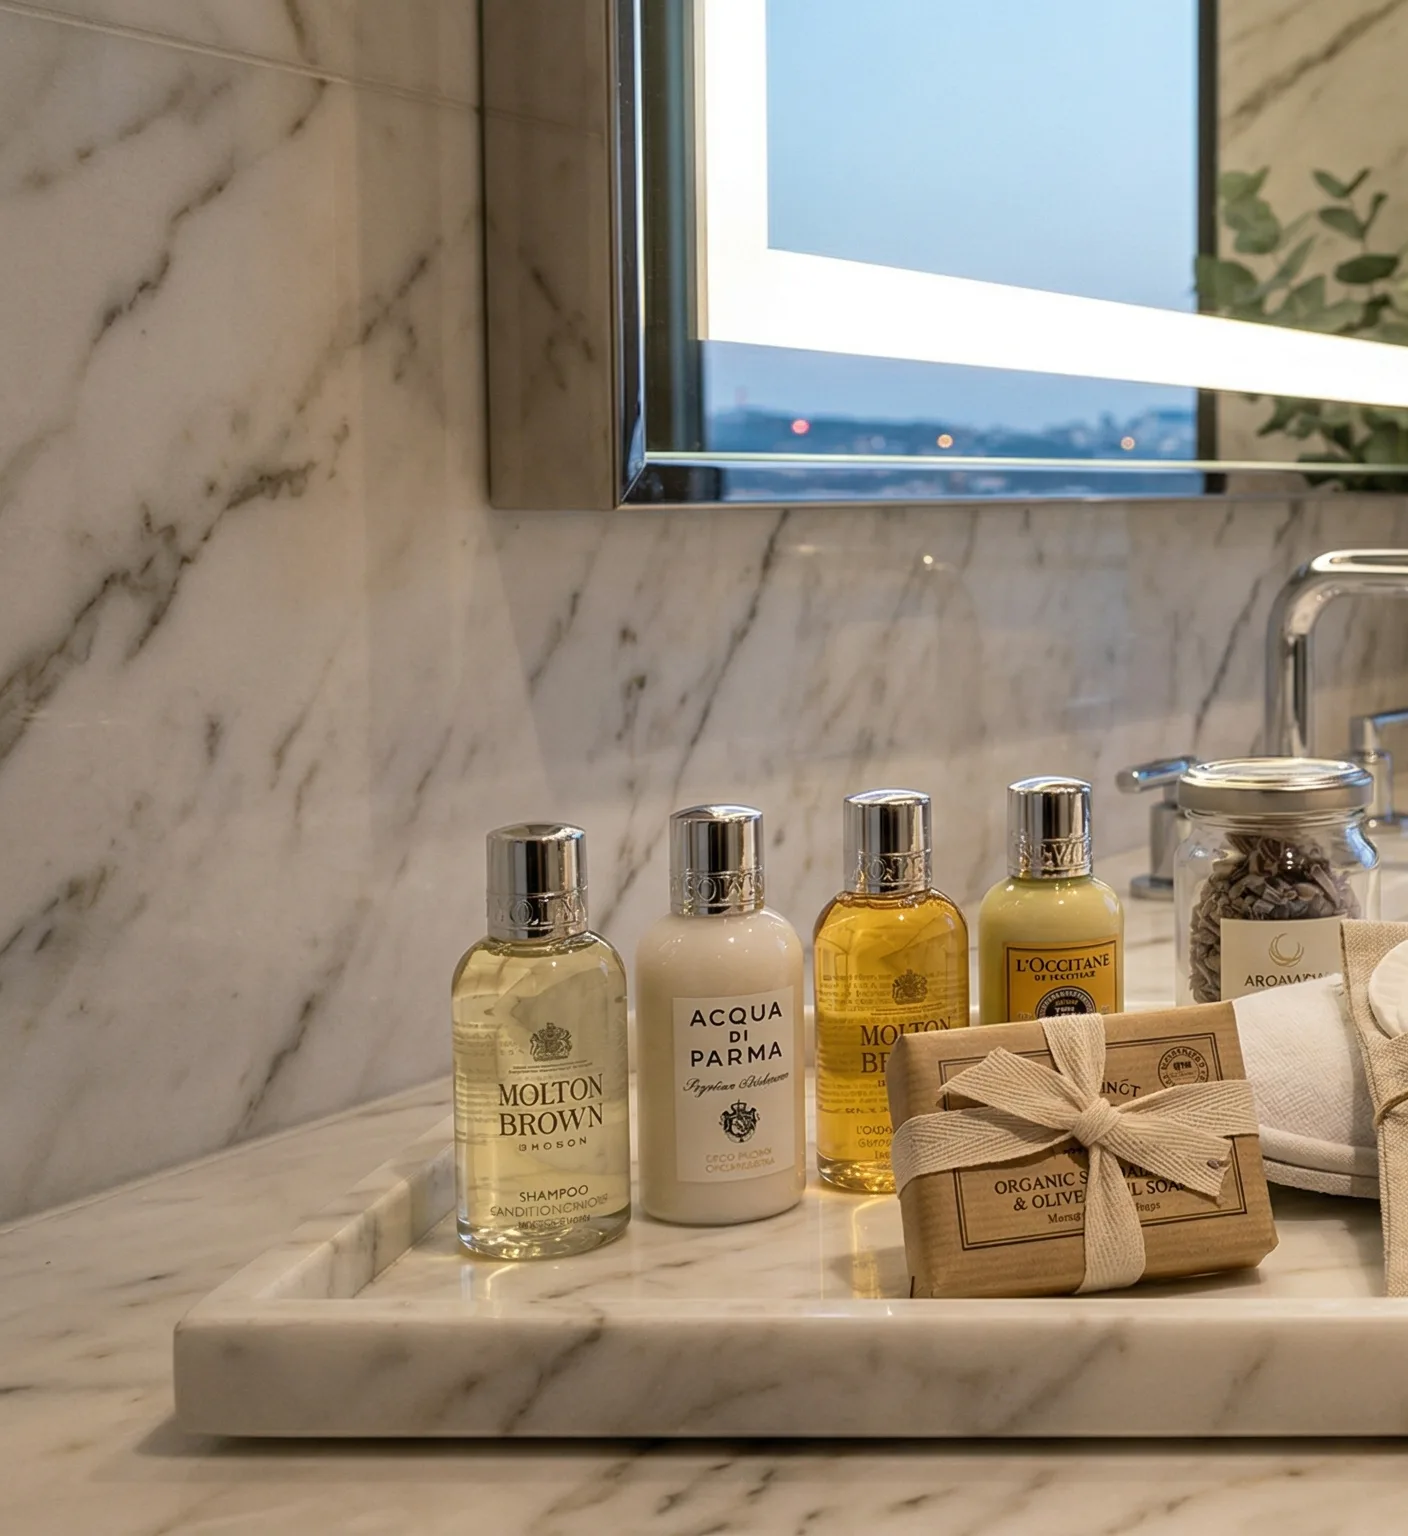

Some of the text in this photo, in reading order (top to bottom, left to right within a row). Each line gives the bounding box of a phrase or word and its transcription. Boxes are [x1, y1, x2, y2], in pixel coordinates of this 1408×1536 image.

[1016, 953, 1110, 973] L'OCCITANE
[690, 1001, 782, 1027] ACQUA
[729, 1030, 748, 1043] DI
[691, 1041, 782, 1067] PARMA
[498, 1074, 603, 1107] MOLTON
[499, 1103, 603, 1136] BROWN
[519, 1184, 589, 1202] SHAMPOO
[995, 1172, 1076, 1195] ORGANIC
[1013, 1190, 1085, 1211] & OLIVE
